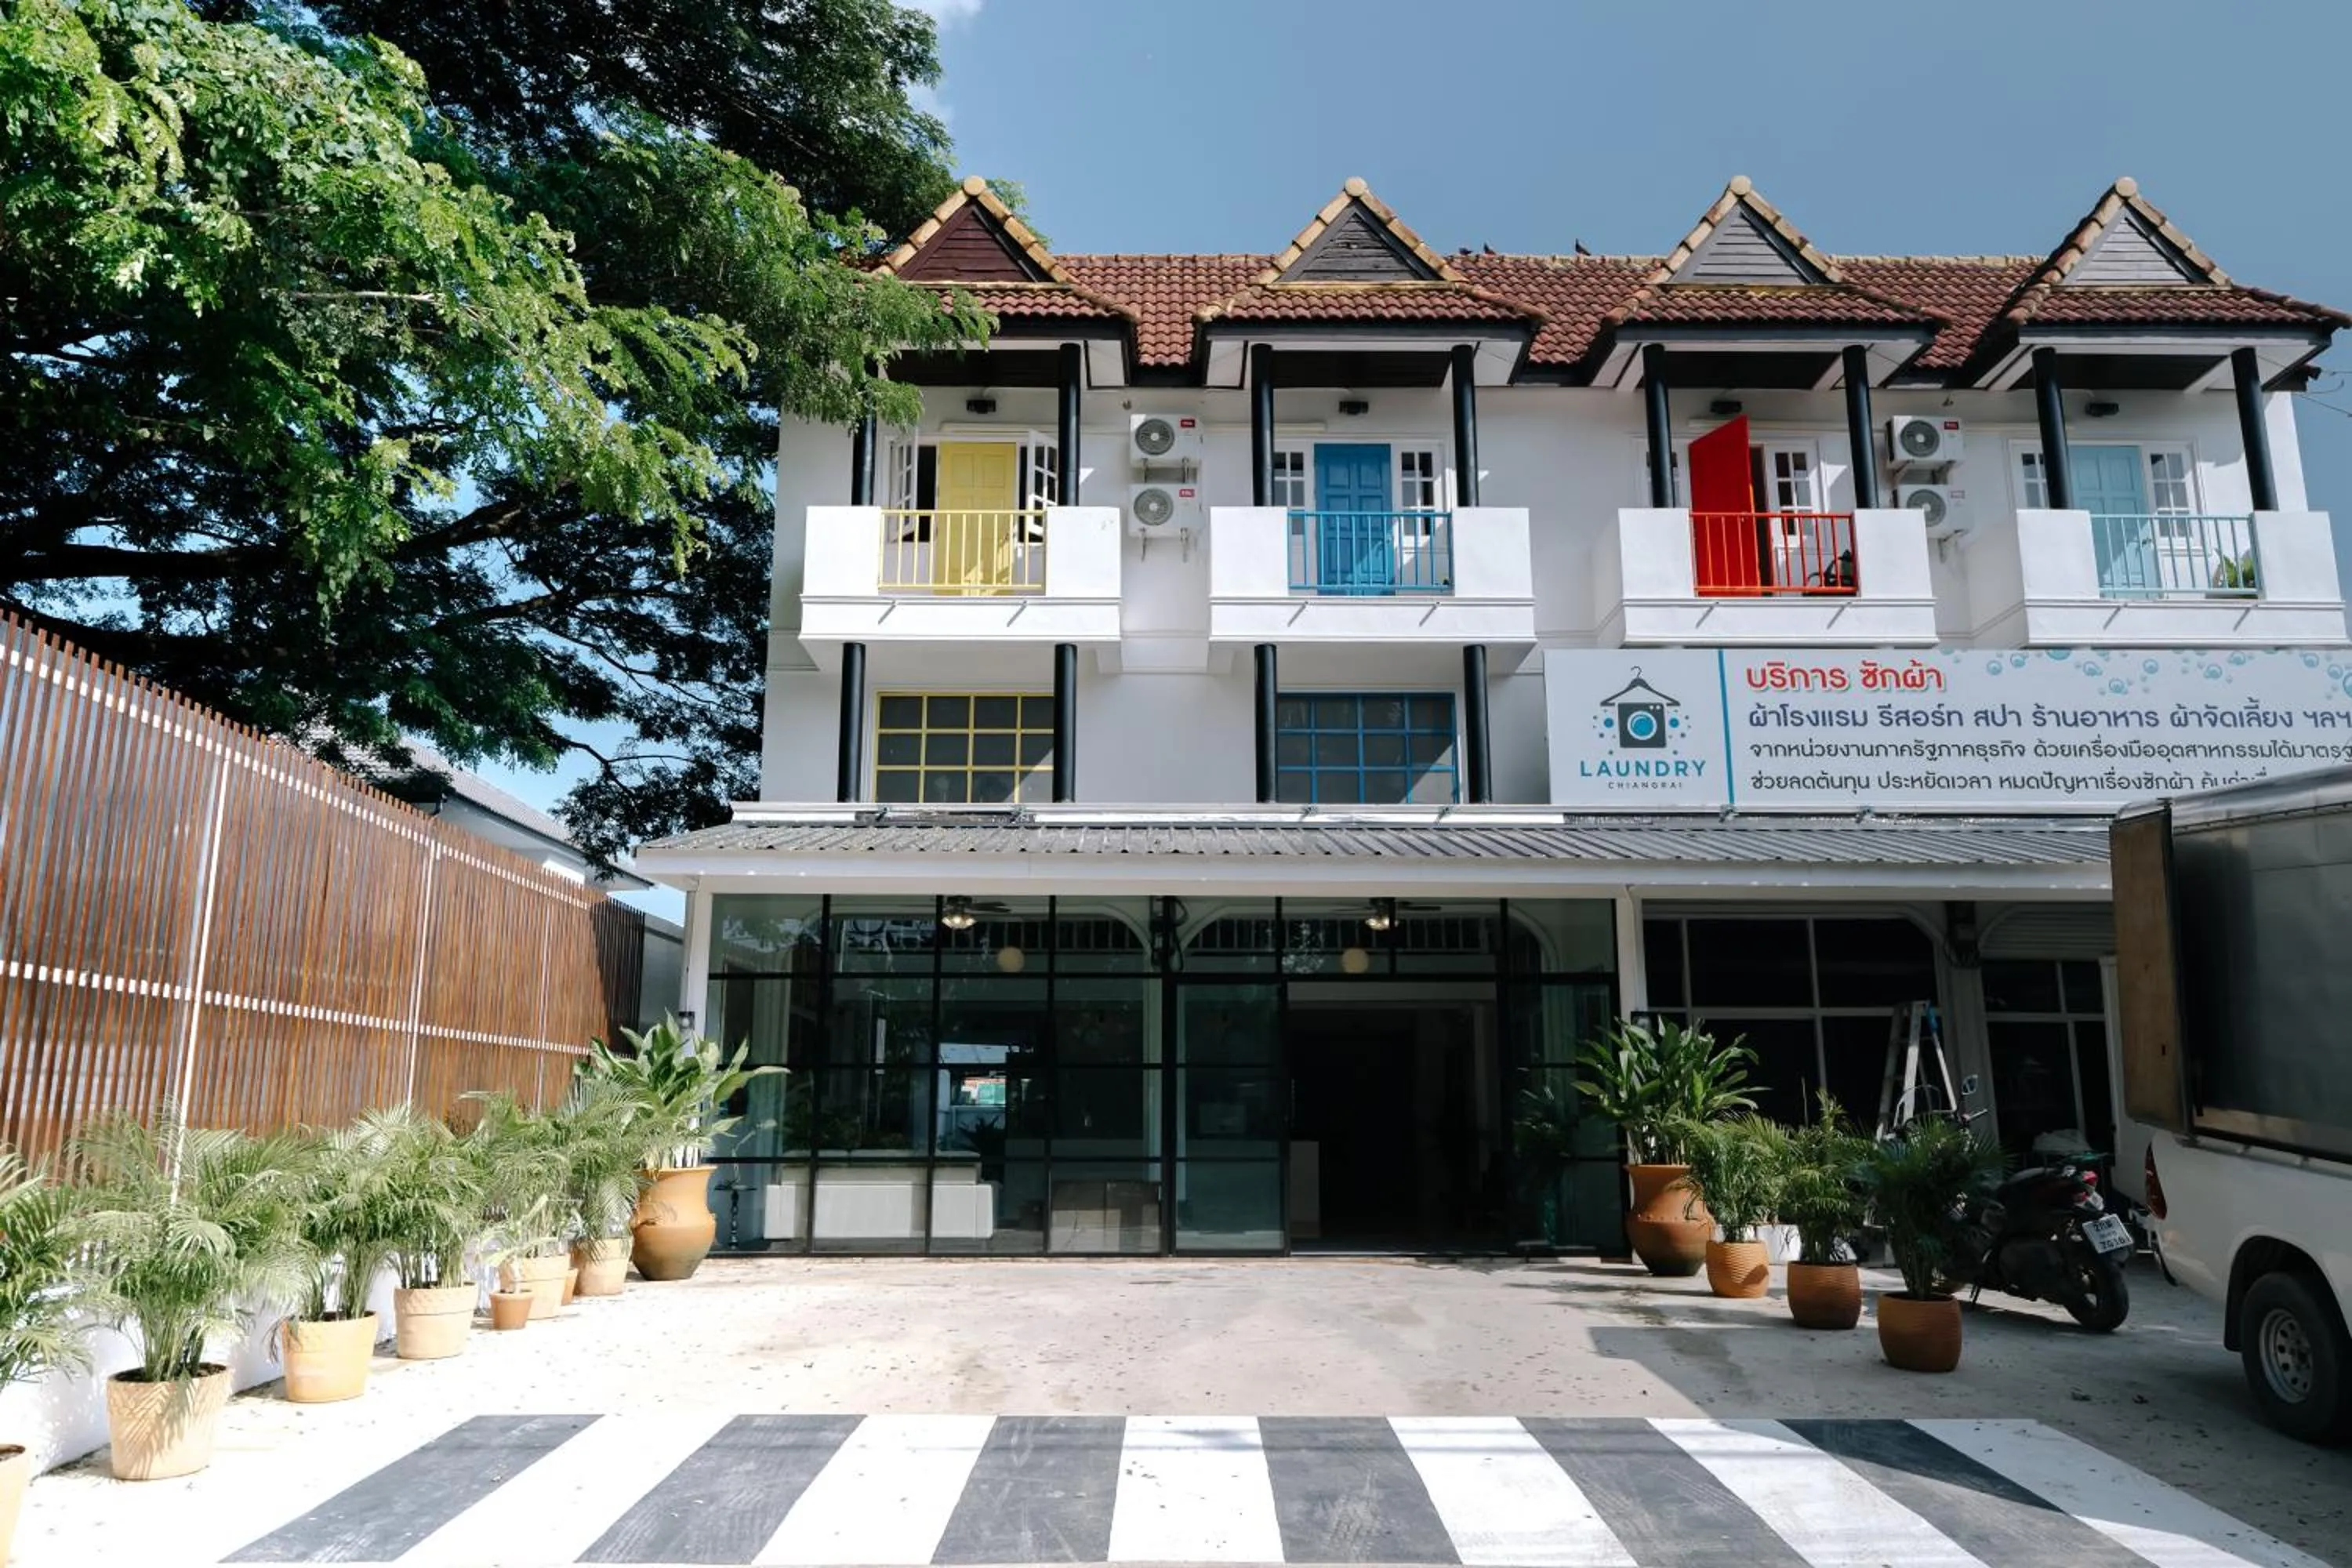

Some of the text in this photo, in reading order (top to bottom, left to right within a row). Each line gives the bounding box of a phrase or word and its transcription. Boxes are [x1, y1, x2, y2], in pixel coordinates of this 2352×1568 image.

[1746, 659, 1945, 691] บริการ ซักผ้า
[1749, 696, 2352, 728] ผ้าโรงแรม รีสอร์ท สปา ร้านอาหาร ผ้าจัดเลี้ยง ฯลฯ
[1580, 760, 1706, 778] LAUNDRY
[1751, 769, 1871, 795] ช่วยลดต้นทุน
[1878, 771, 1992, 789] ประหยัดเวลา
